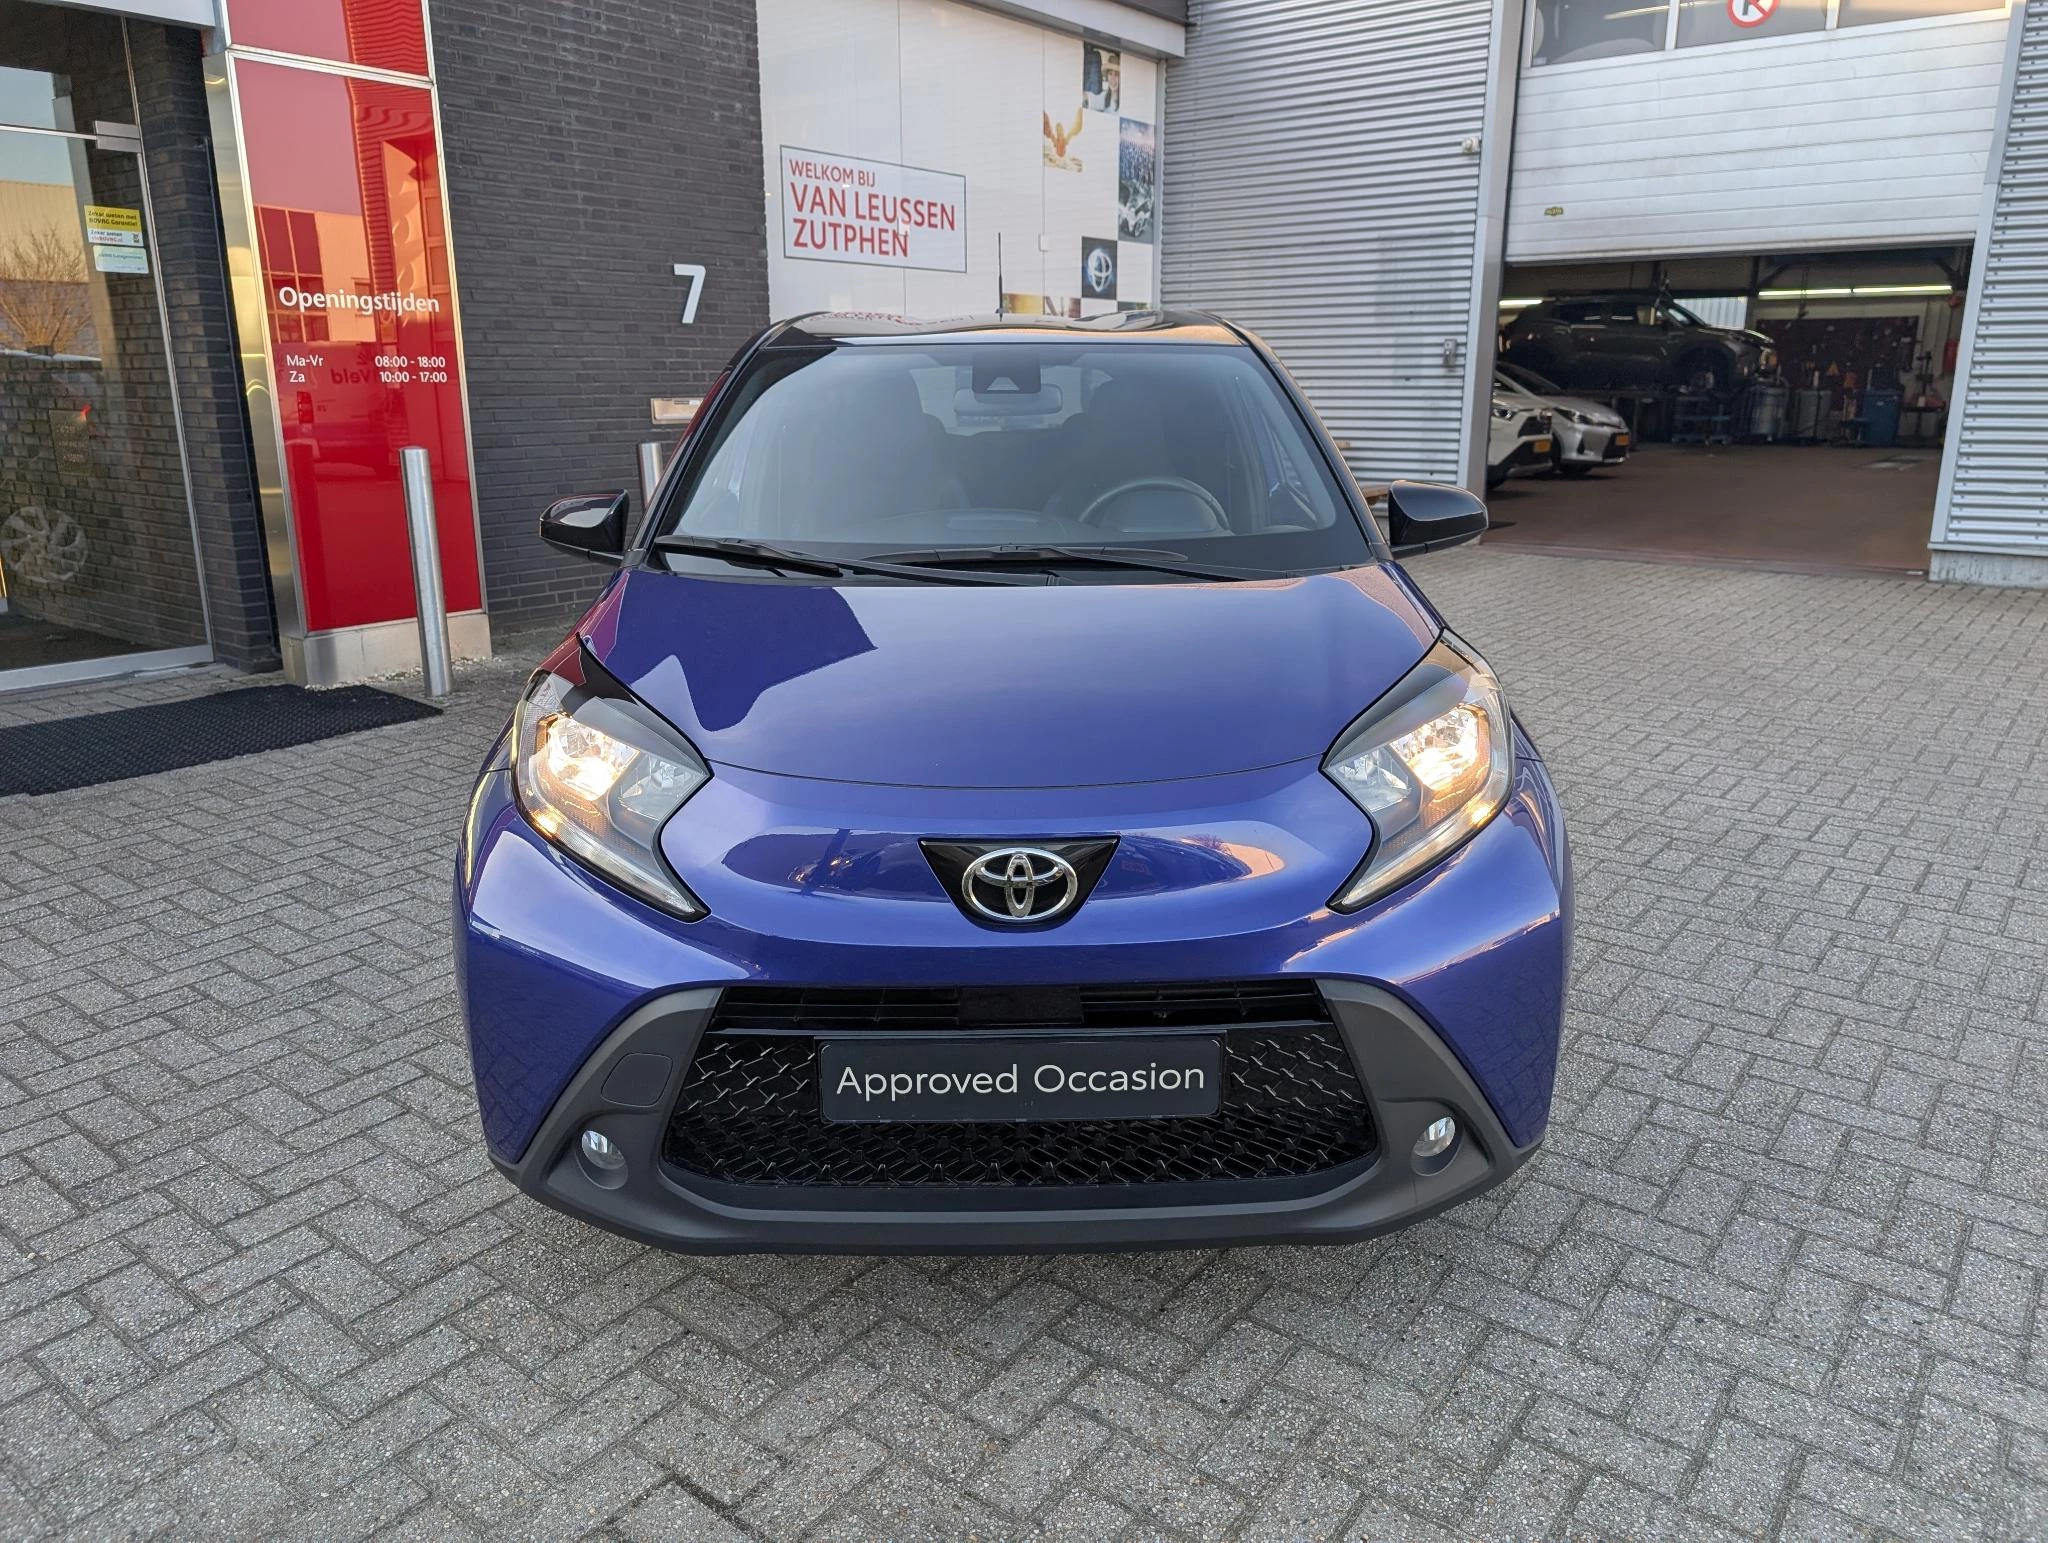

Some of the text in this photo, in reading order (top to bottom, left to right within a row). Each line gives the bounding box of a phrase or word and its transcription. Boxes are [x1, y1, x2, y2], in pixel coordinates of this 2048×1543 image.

[789, 159, 876, 188] WELKOM BIJ
[790, 182, 955, 231] VAN LEUSSEN
[793, 218, 908, 257] ZUTPHEN
[279, 287, 440, 316] Openingstijden
[674, 264, 706, 324] 7
[286, 354, 324, 367] Ma-Vr
[375, 356, 408, 368] 08:00
[416, 356, 446, 368] 18:00
[289, 371, 306, 383] Za
[379, 371, 410, 383] 10:00
[418, 371, 448, 383] 17:00
[836, 1062, 1205, 1101] Approved Occasion
